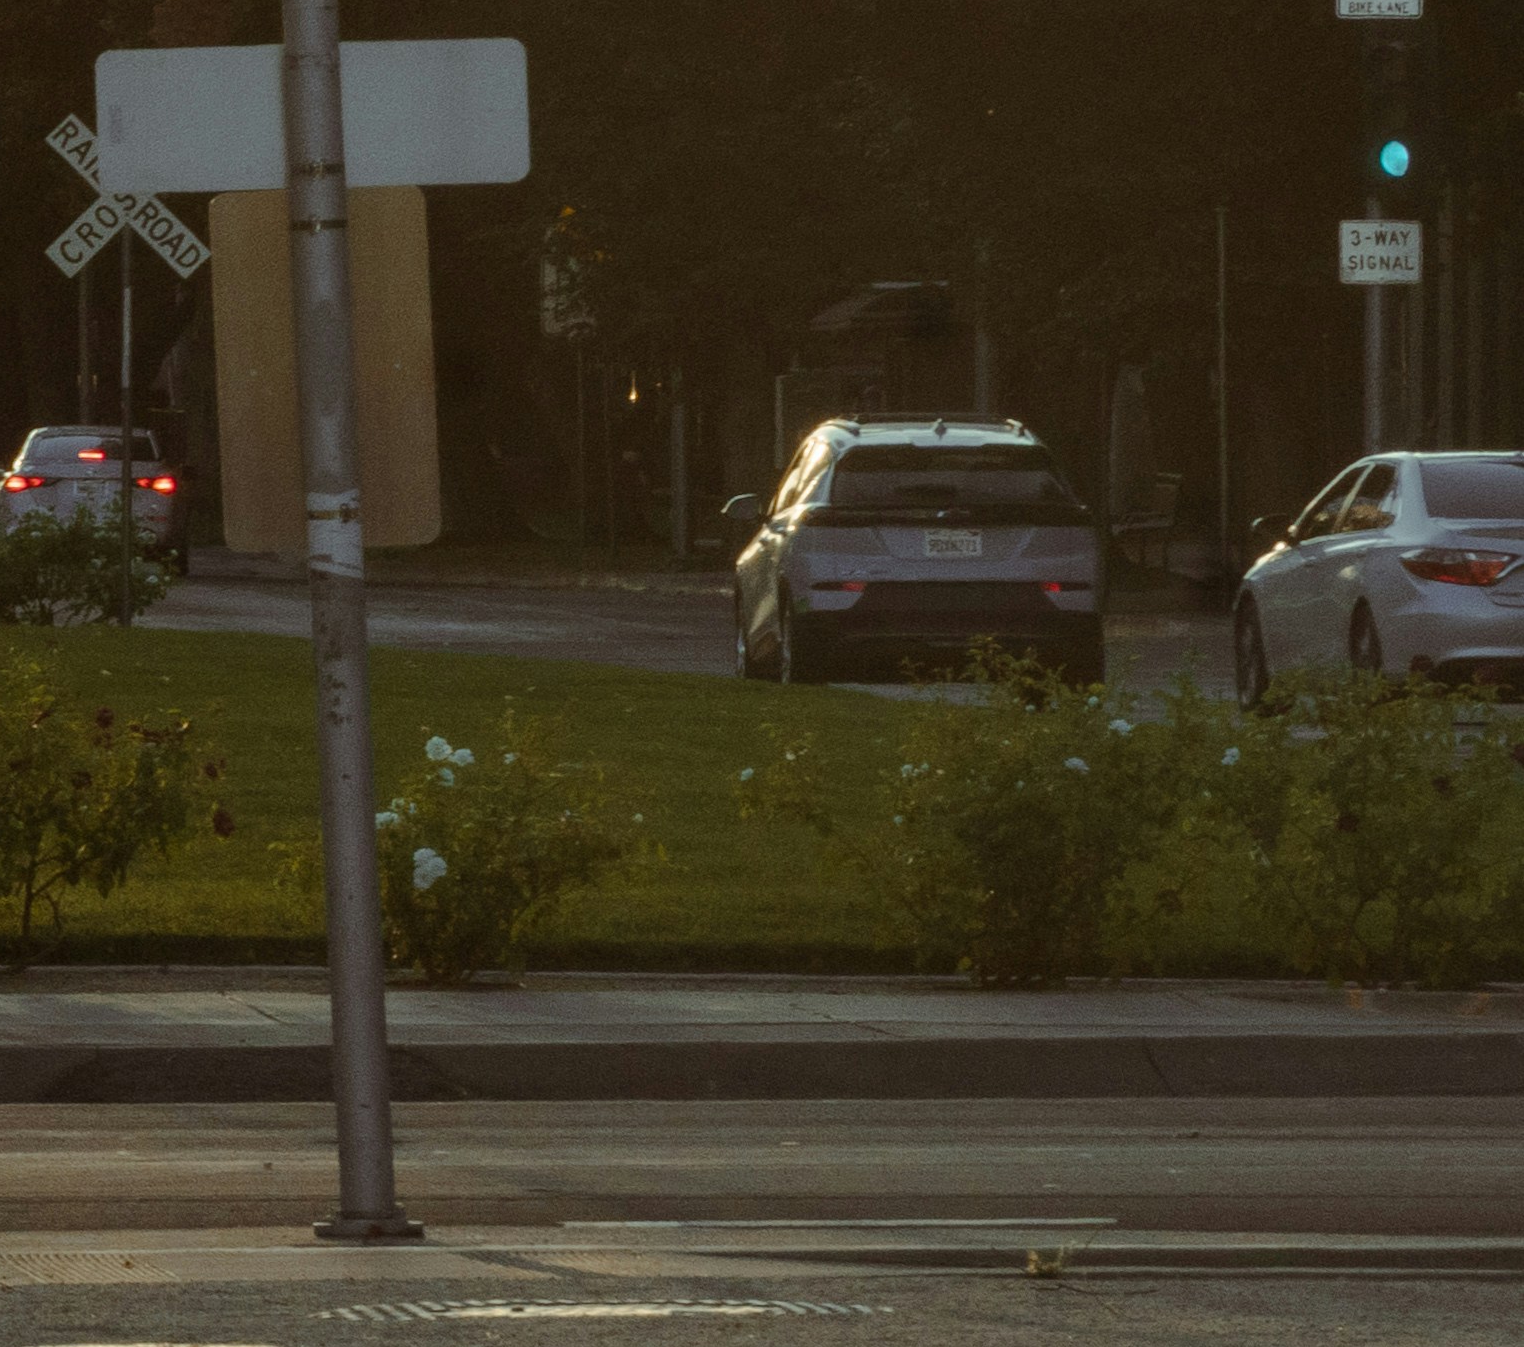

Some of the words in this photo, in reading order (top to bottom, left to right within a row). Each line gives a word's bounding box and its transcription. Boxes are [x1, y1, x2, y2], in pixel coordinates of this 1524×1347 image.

[1348, 2, 1373, 14] BIKE
[1377, 2, 1409, 14] LANE
[133, 201, 202, 269] ROAD
[1350, 229, 1411, 246] 3-WAY
[1348, 254, 1415, 271] SIGNAL
